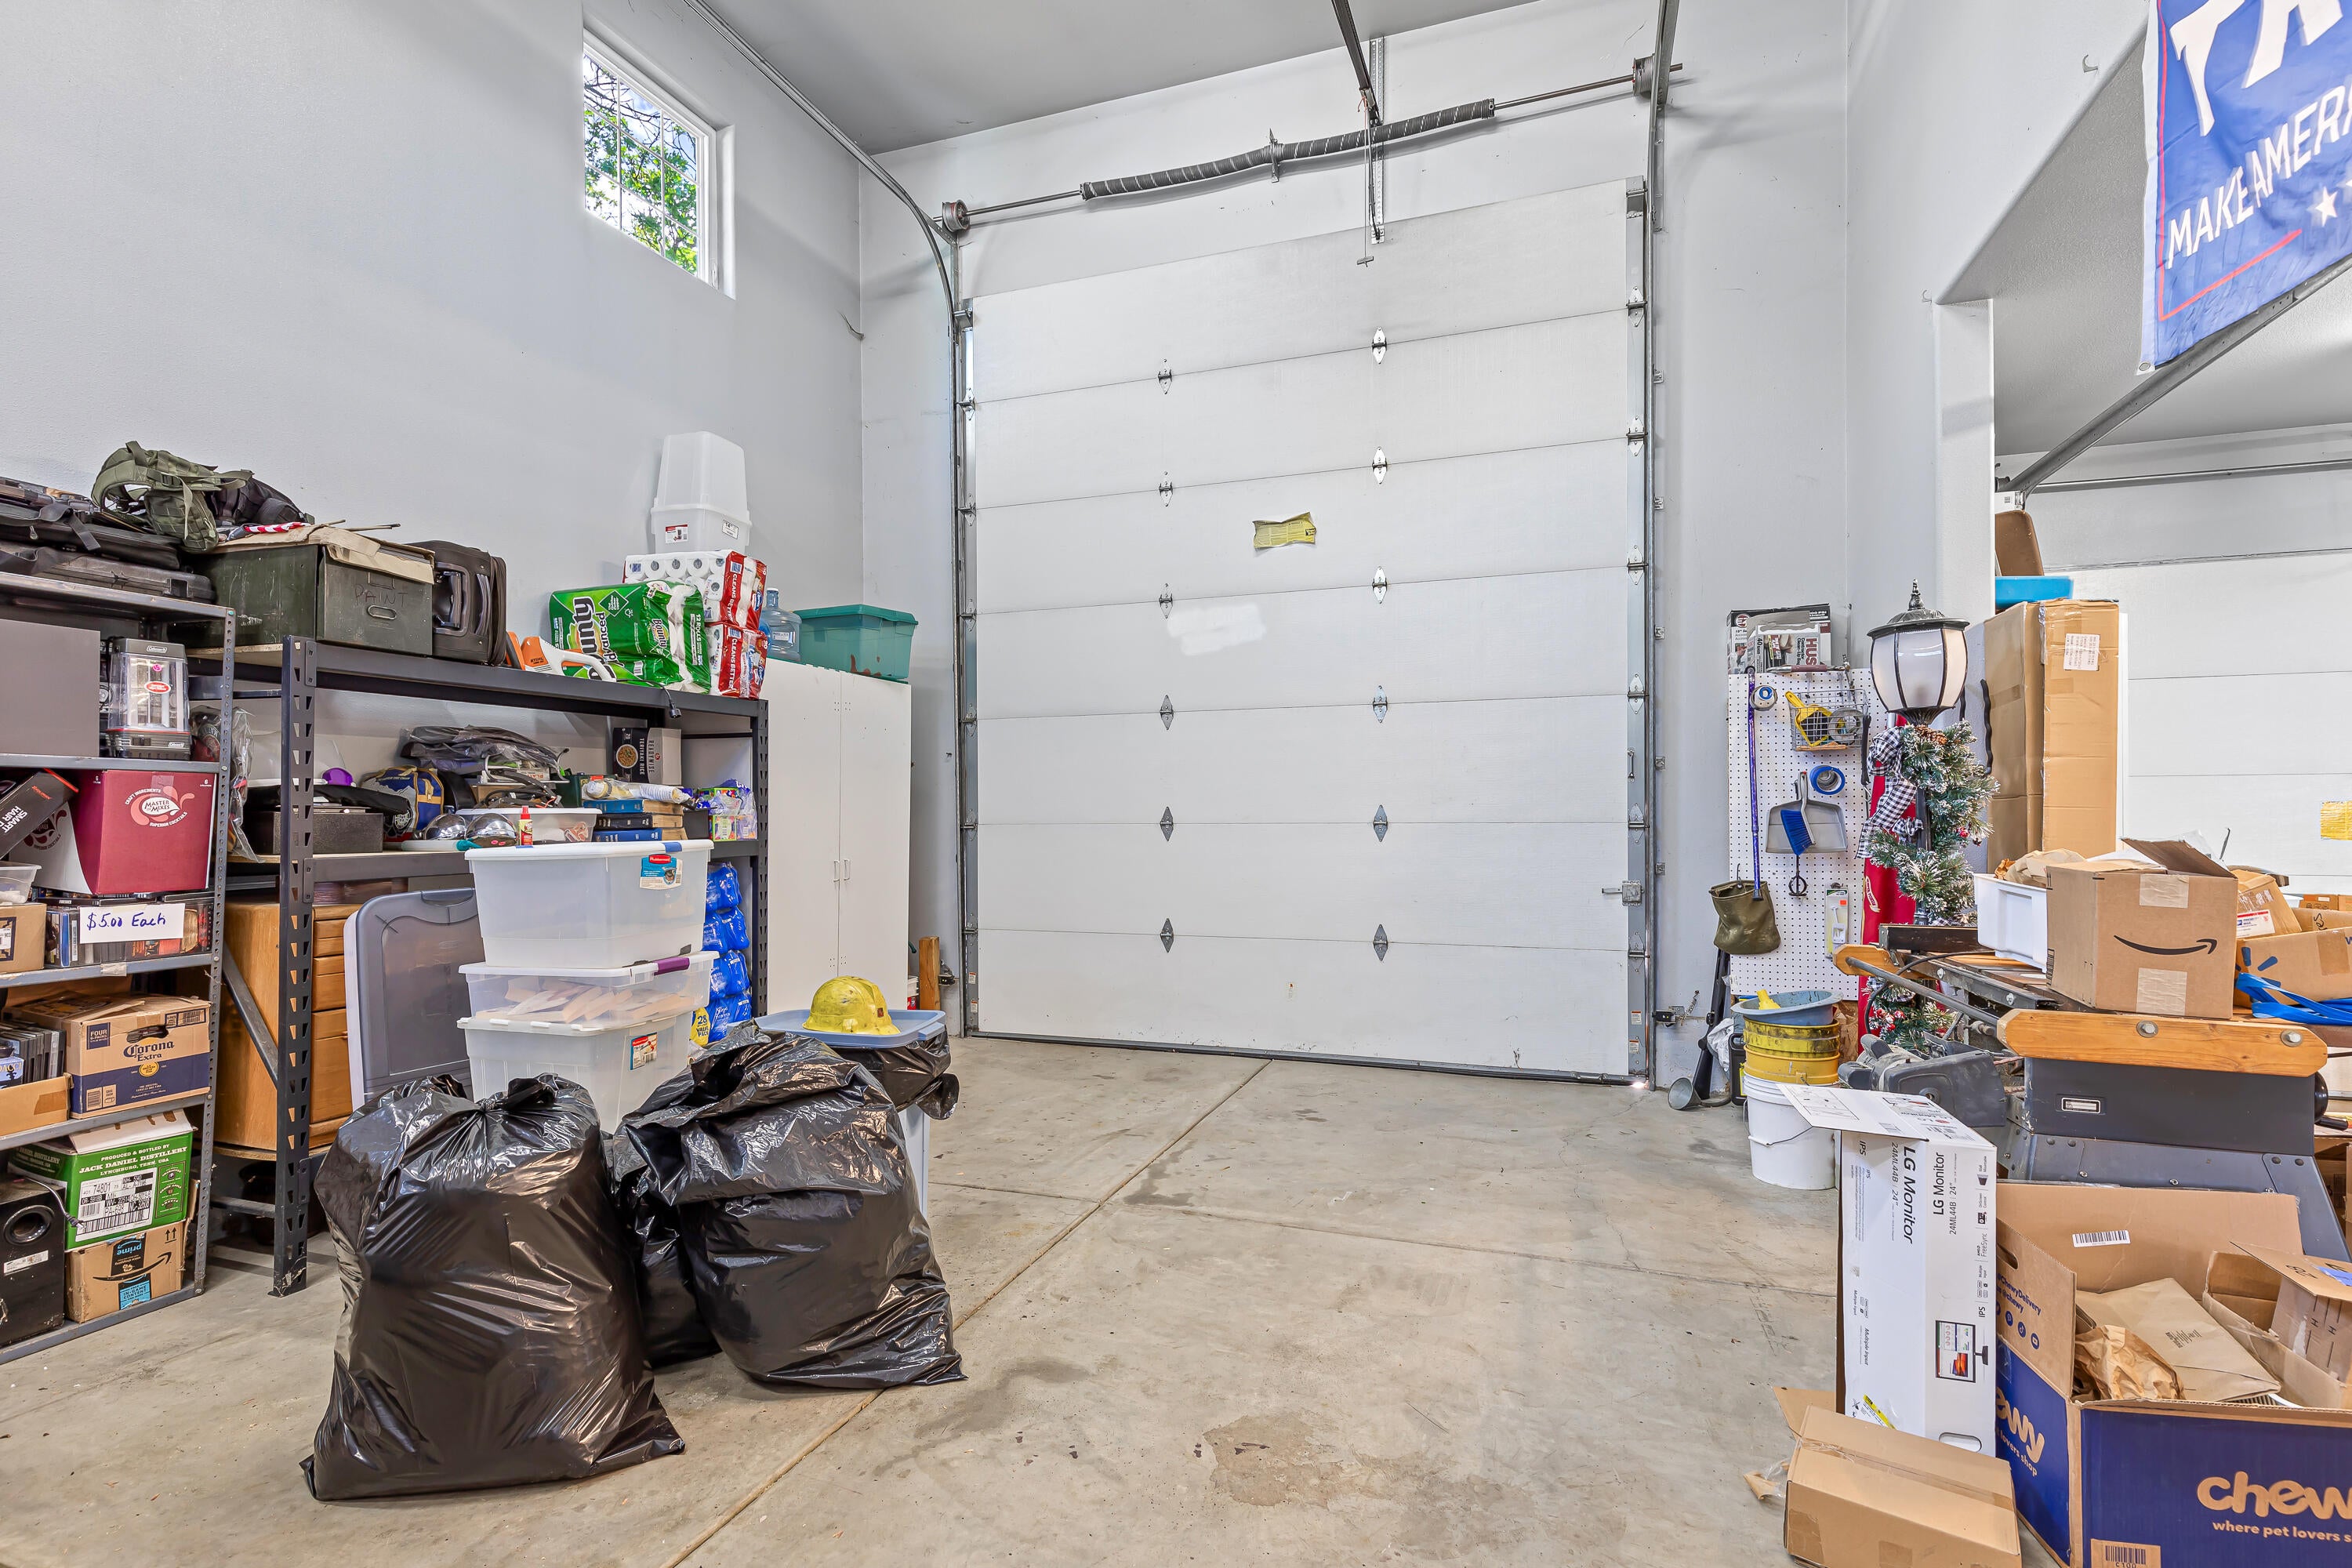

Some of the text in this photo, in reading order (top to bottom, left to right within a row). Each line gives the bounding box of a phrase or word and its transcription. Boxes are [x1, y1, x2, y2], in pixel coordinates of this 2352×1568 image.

[2167, 165, 2254, 270] MAKE
[355, 584, 408, 608] PAINT
[652, 618, 667, 648] Bounty
[1757, 637, 1762, 646] 40
[2, 805, 22, 822] HAIR
[144, 800, 169, 810] MASTER
[2, 811, 28, 833] SMART
[697, 1014, 708, 1025] 28
[90, 1029, 107, 1037] FOUR
[123, 1040, 175, 1058] Corona
[137, 1053, 162, 1062] Extra
[79, 1146, 188, 1174] JACK DANIEL DISTILLERY
[100, 1153, 131, 1162] PRODUCED
[93, 1182, 111, 1195] 74801
[1933, 1152, 1944, 1215] LG Monitor
[1904, 1146, 1916, 1245] LG Monitor
[117, 1243, 142, 1255] prime
[123, 1286, 147, 1296] IN-GAME
[2000, 1429, 2038, 1477] lovers shop
[2212, 1520, 2259, 1534] where
[2263, 1526, 2289, 1538] pet
[2292, 1526, 2340, 1542] lovers
